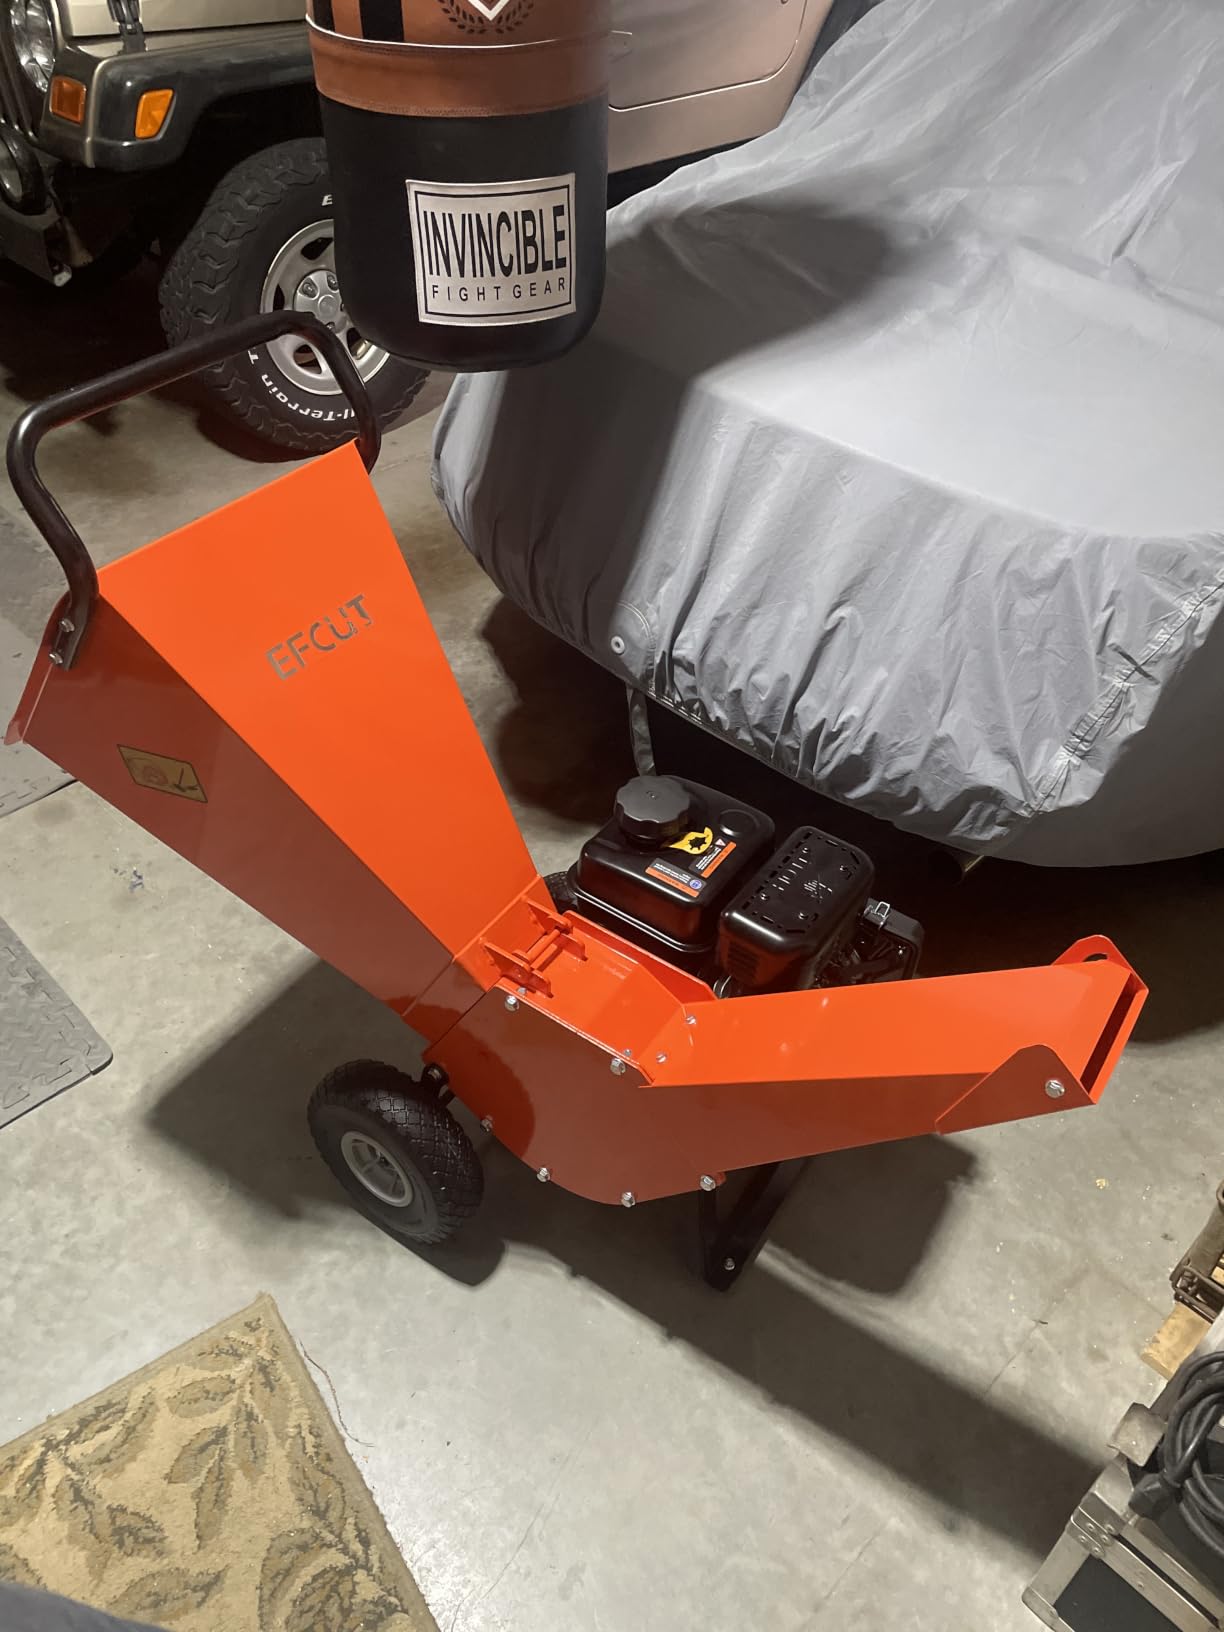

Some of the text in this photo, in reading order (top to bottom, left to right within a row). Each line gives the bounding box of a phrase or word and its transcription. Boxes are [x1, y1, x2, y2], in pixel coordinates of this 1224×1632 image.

[423, 204, 567, 278] INVINCIBLE
[432, 277, 566, 301] FIGHT GEAR
[261, 374, 356, 421] ll-Terrain
[266, 594, 373, 680] EFCUT
